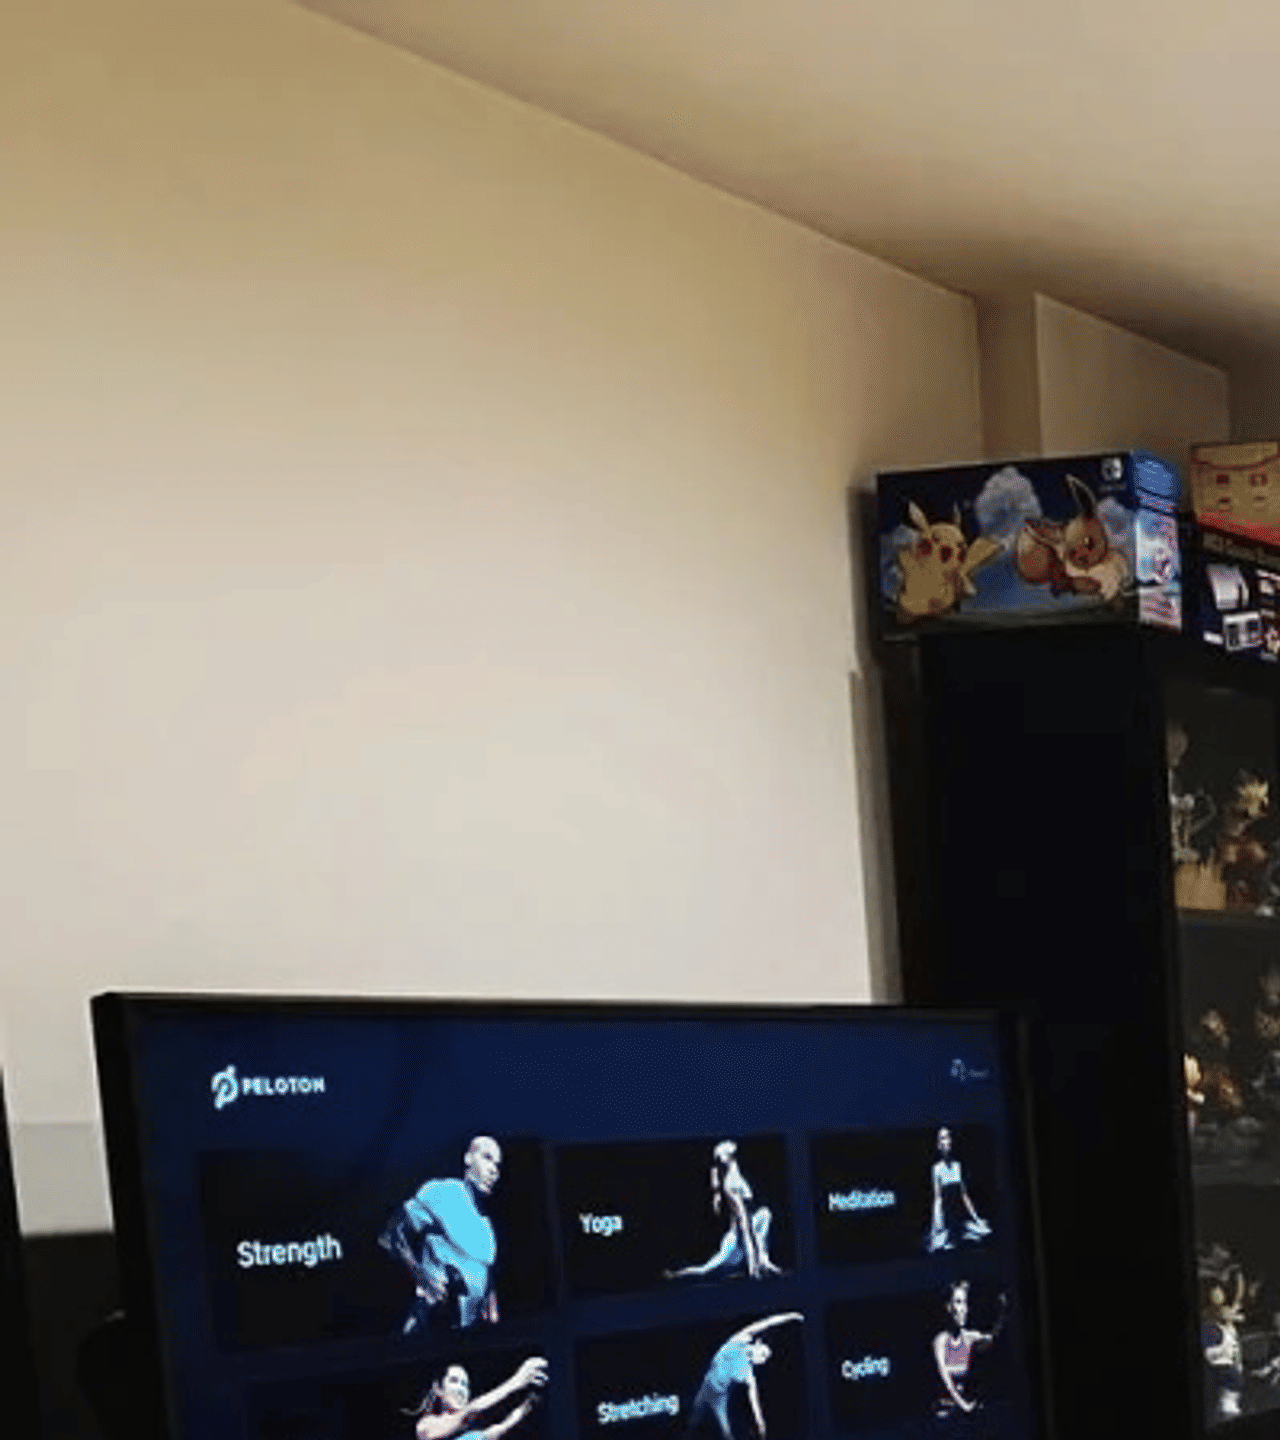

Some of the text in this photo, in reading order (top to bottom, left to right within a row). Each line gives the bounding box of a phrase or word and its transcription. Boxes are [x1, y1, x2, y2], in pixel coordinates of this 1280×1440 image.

[241, 1076, 326, 1095] PELOTON
[828, 1188, 896, 1212] Meditation
[579, 1212, 623, 1237] Yoga
[236, 1232, 343, 1269] Strength
[841, 1355, 890, 1380] Cycling
[597, 1392, 679, 1425] Stretching
